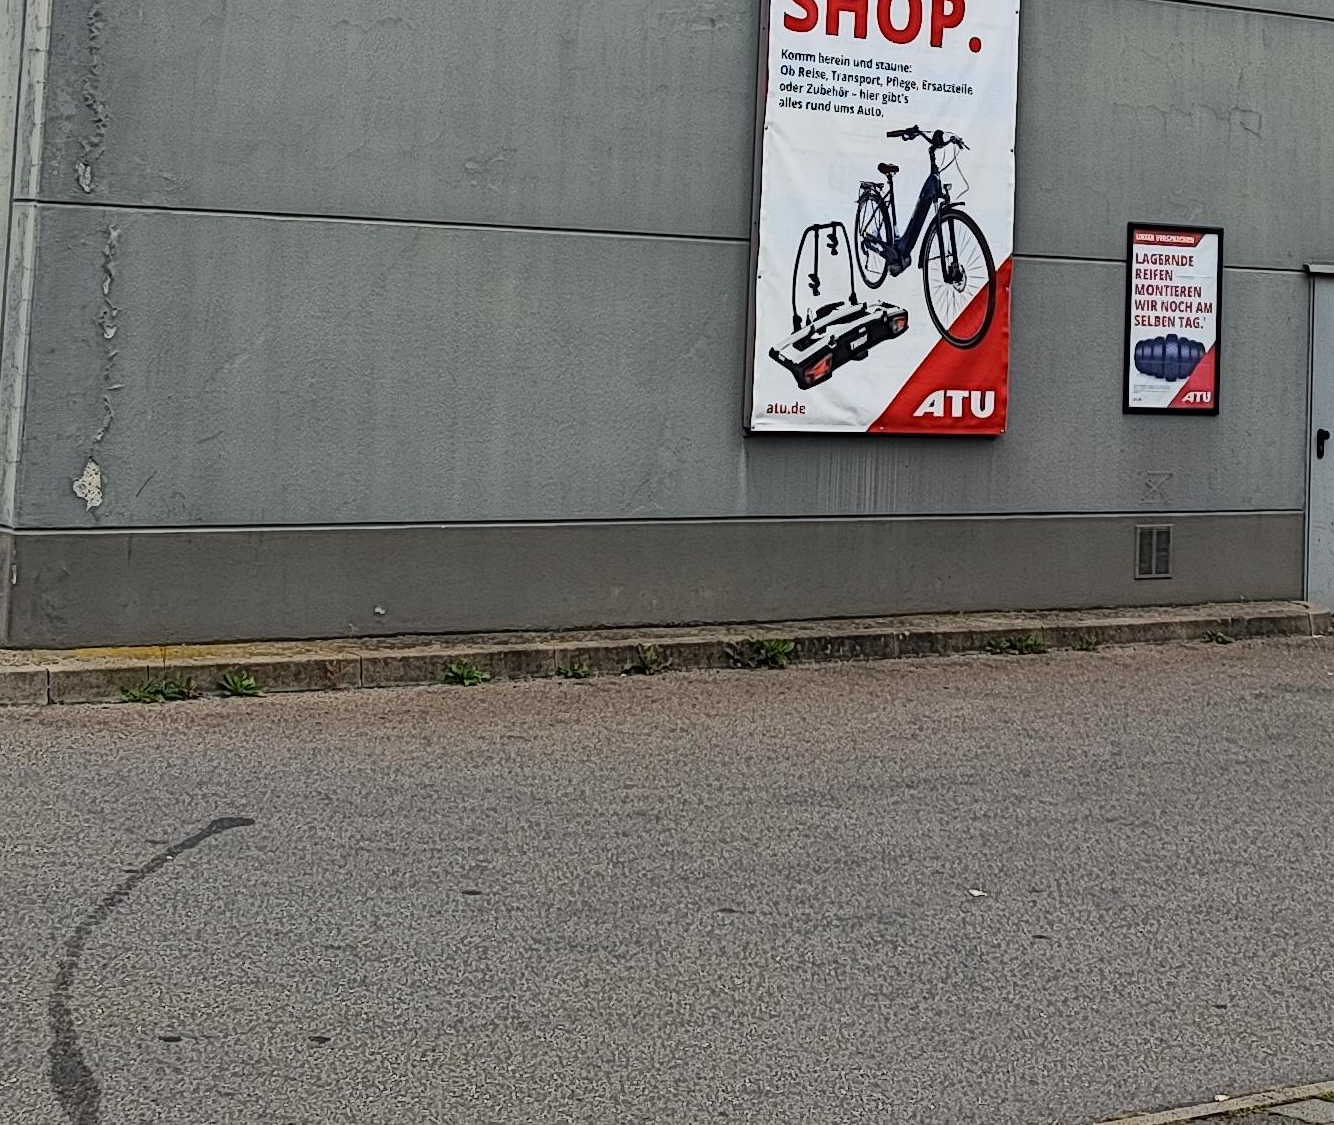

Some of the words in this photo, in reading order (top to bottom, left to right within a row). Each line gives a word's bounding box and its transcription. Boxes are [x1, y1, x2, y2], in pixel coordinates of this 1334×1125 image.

[781, 48, 816, 62] Komm
[818, 52, 850, 67] herein
[853, 58, 873, 69] und
[875, 61, 912, 73] staune:
[780, 64, 795, 76] Ob
[798, 66, 829, 81] Reise,
[831, 70, 883, 87] Transport,
[886, 76, 919, 91] Pflege,
[922, 79, 974, 95] Ersatzteile
[779, 81, 804, 93] oder
[806, 83, 850, 98] Zubehör
[859, 88, 880, 101] hier
[881, 92, 910, 105] gibt's
[778, 96, 803, 109] alles
[805, 100, 832, 112] rund
[833, 104, 855, 115] ums
[857, 105, 884, 117] Auto.
[1135, 252, 1194, 267] LAGERNDE
[1135, 268, 1173, 281] REIFEN
[1134, 283, 1202, 298] MONTIEREN
[1134, 299, 1158, 312] WIR
[1160, 300, 1193, 313] NOCH
[1195, 301, 1213, 314] AM
[1134, 315, 1176, 328] SELBEN
[913, 389, 996, 419] ATU
[1181, 391, 1212, 403] ATU
[766, 401, 806, 415] atu.de
